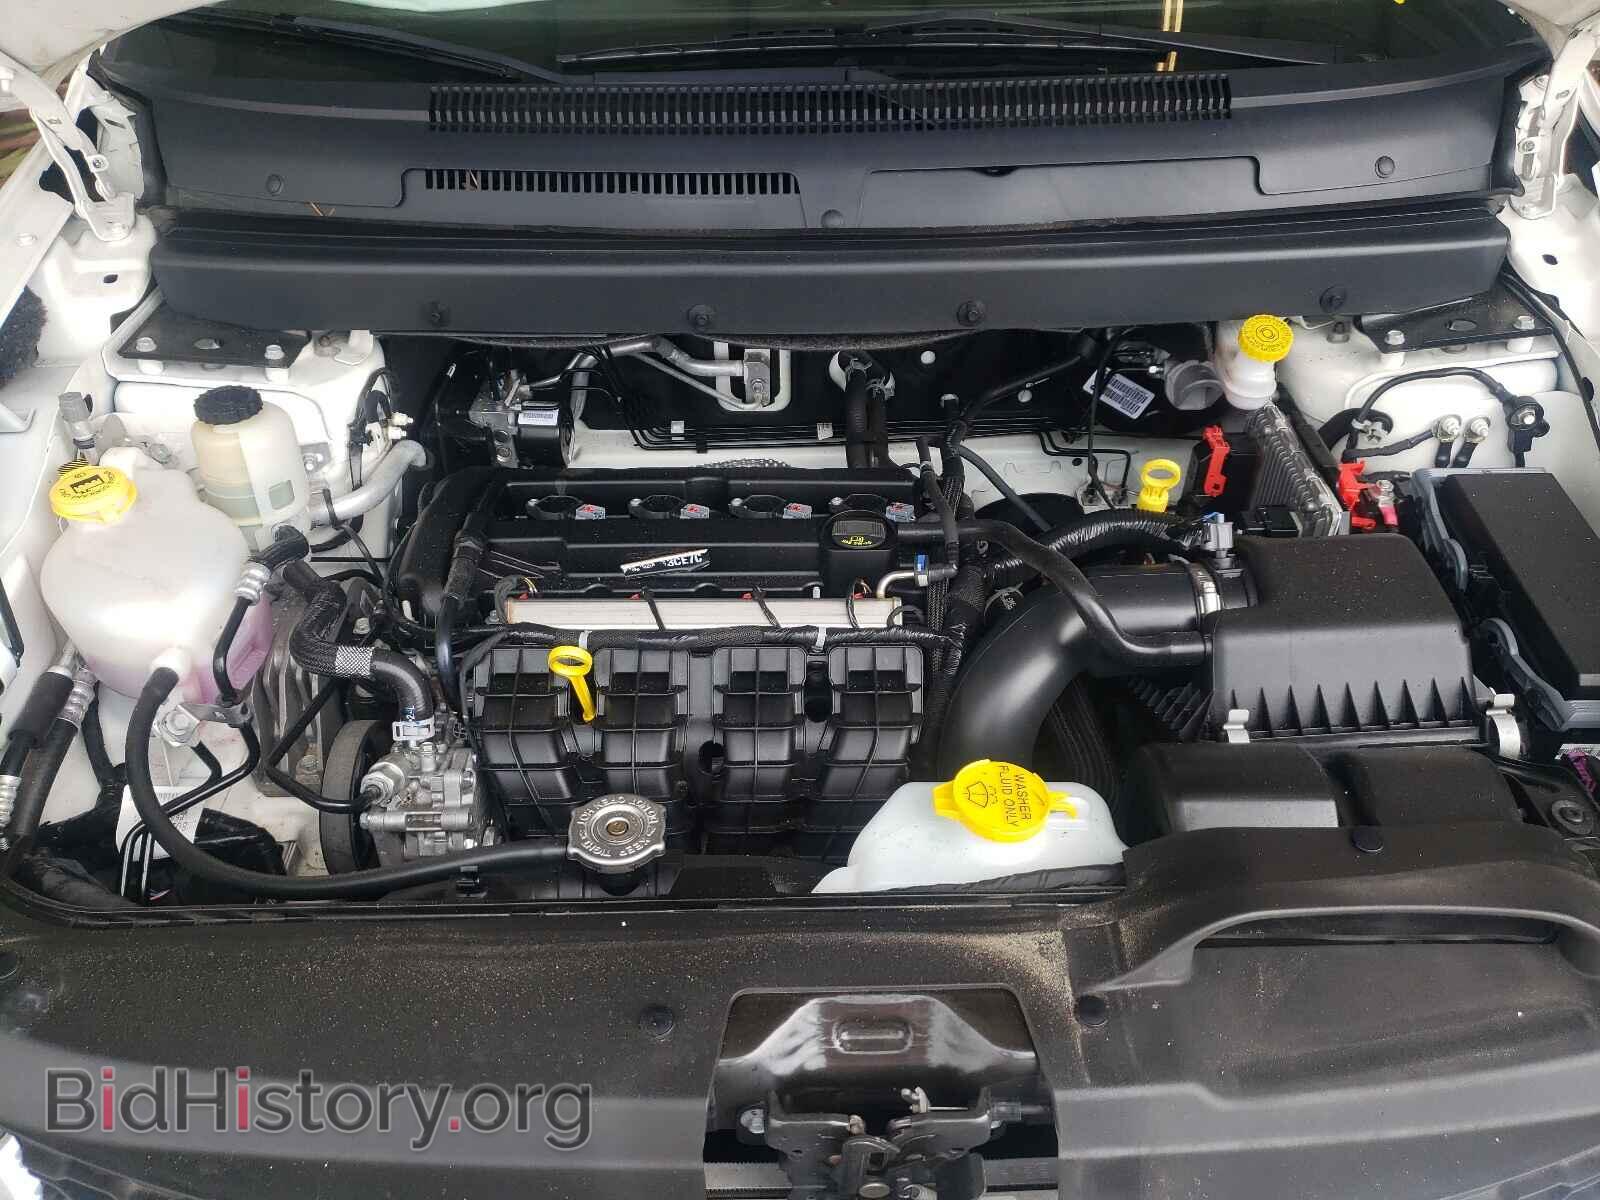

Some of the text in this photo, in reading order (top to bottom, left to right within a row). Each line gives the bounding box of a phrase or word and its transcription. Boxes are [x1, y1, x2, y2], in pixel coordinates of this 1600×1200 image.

[999, 765, 1019, 828] FLUID ONLY
[1014, 773, 1032, 821] WASHER
